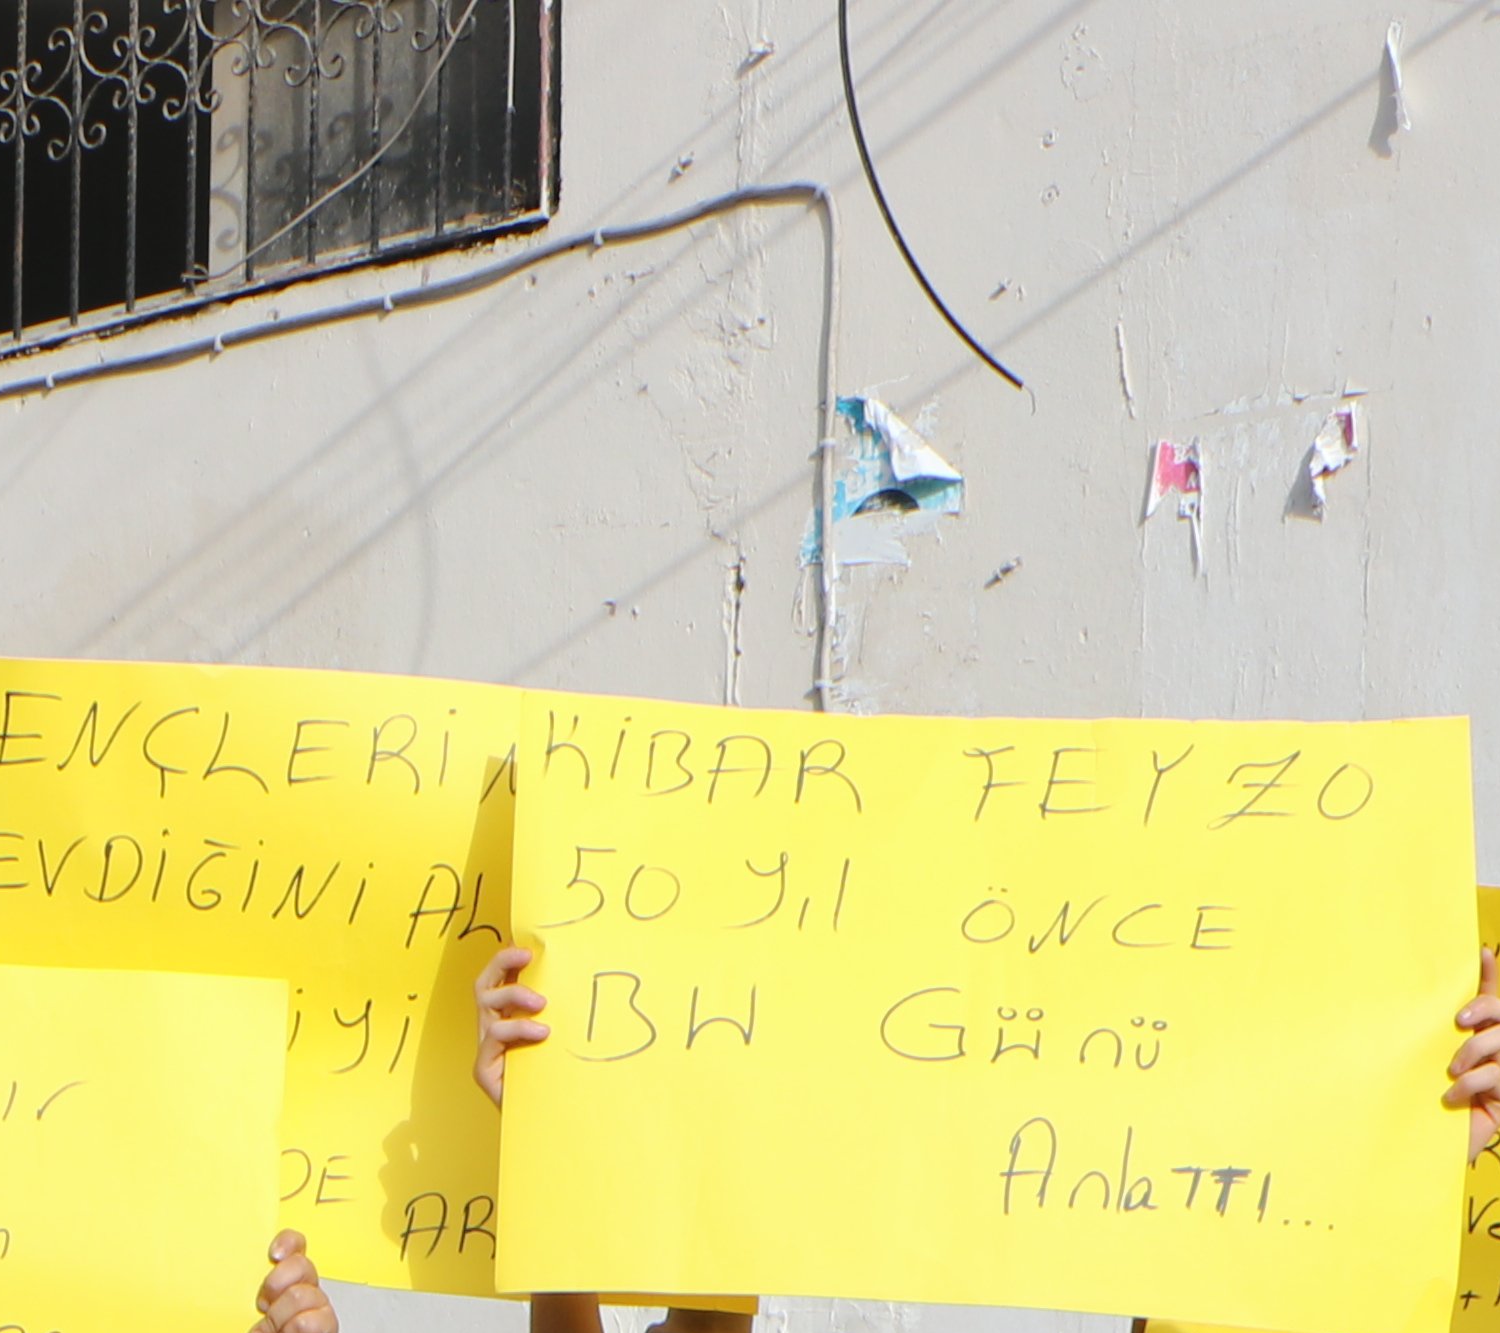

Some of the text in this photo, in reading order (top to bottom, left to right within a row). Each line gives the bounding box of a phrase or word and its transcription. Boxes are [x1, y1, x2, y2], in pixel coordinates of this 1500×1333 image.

[542, 709, 1376, 829] KİBAR FEYZO
[536, 845, 682, 930] 50
[957, 886, 1237, 957] ÖNCE
